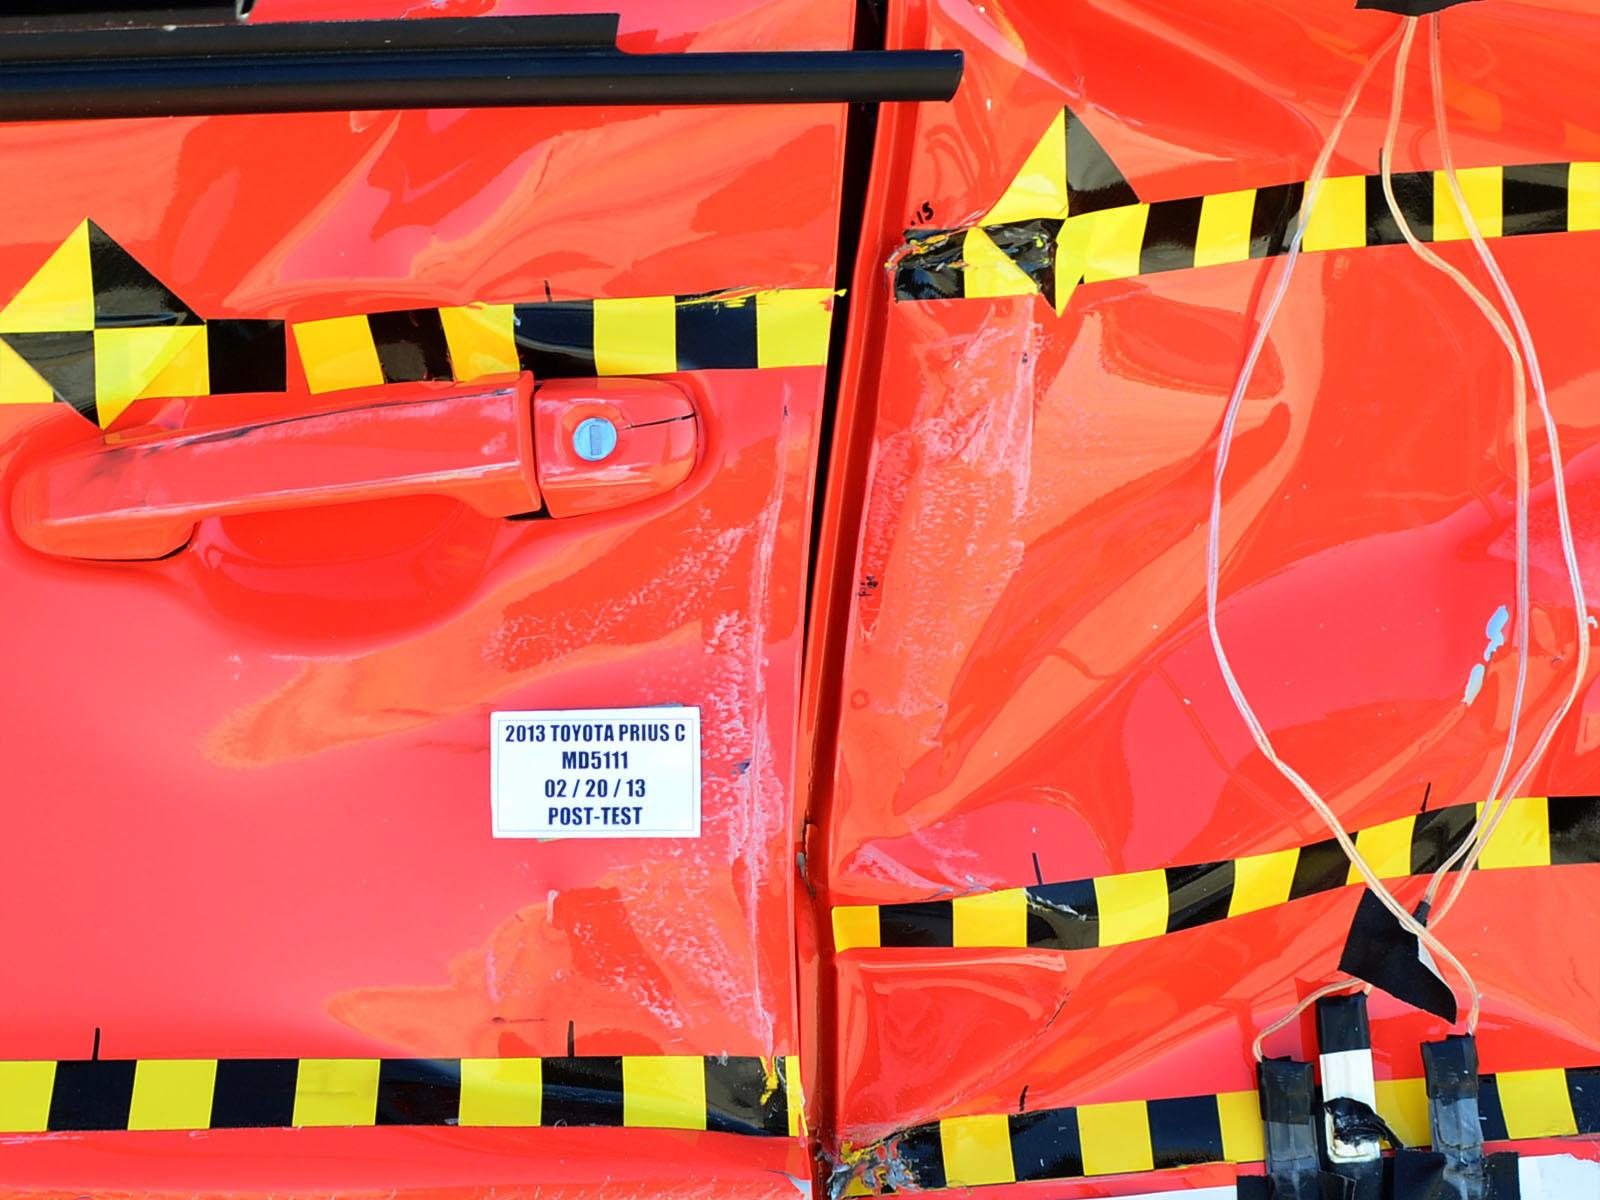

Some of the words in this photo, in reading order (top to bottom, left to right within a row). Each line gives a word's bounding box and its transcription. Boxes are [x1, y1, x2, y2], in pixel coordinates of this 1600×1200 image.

[505, 724, 546, 742] 2013
[551, 724, 615, 742] TOYOTA
[619, 723, 670, 742] PRIUS
[675, 723, 686, 742] C
[562, 751, 628, 769] MD5111
[544, 779, 567, 798] 02
[585, 779, 608, 798] 20
[626, 779, 646, 798] 13
[548, 806, 643, 826] POST-TEST
